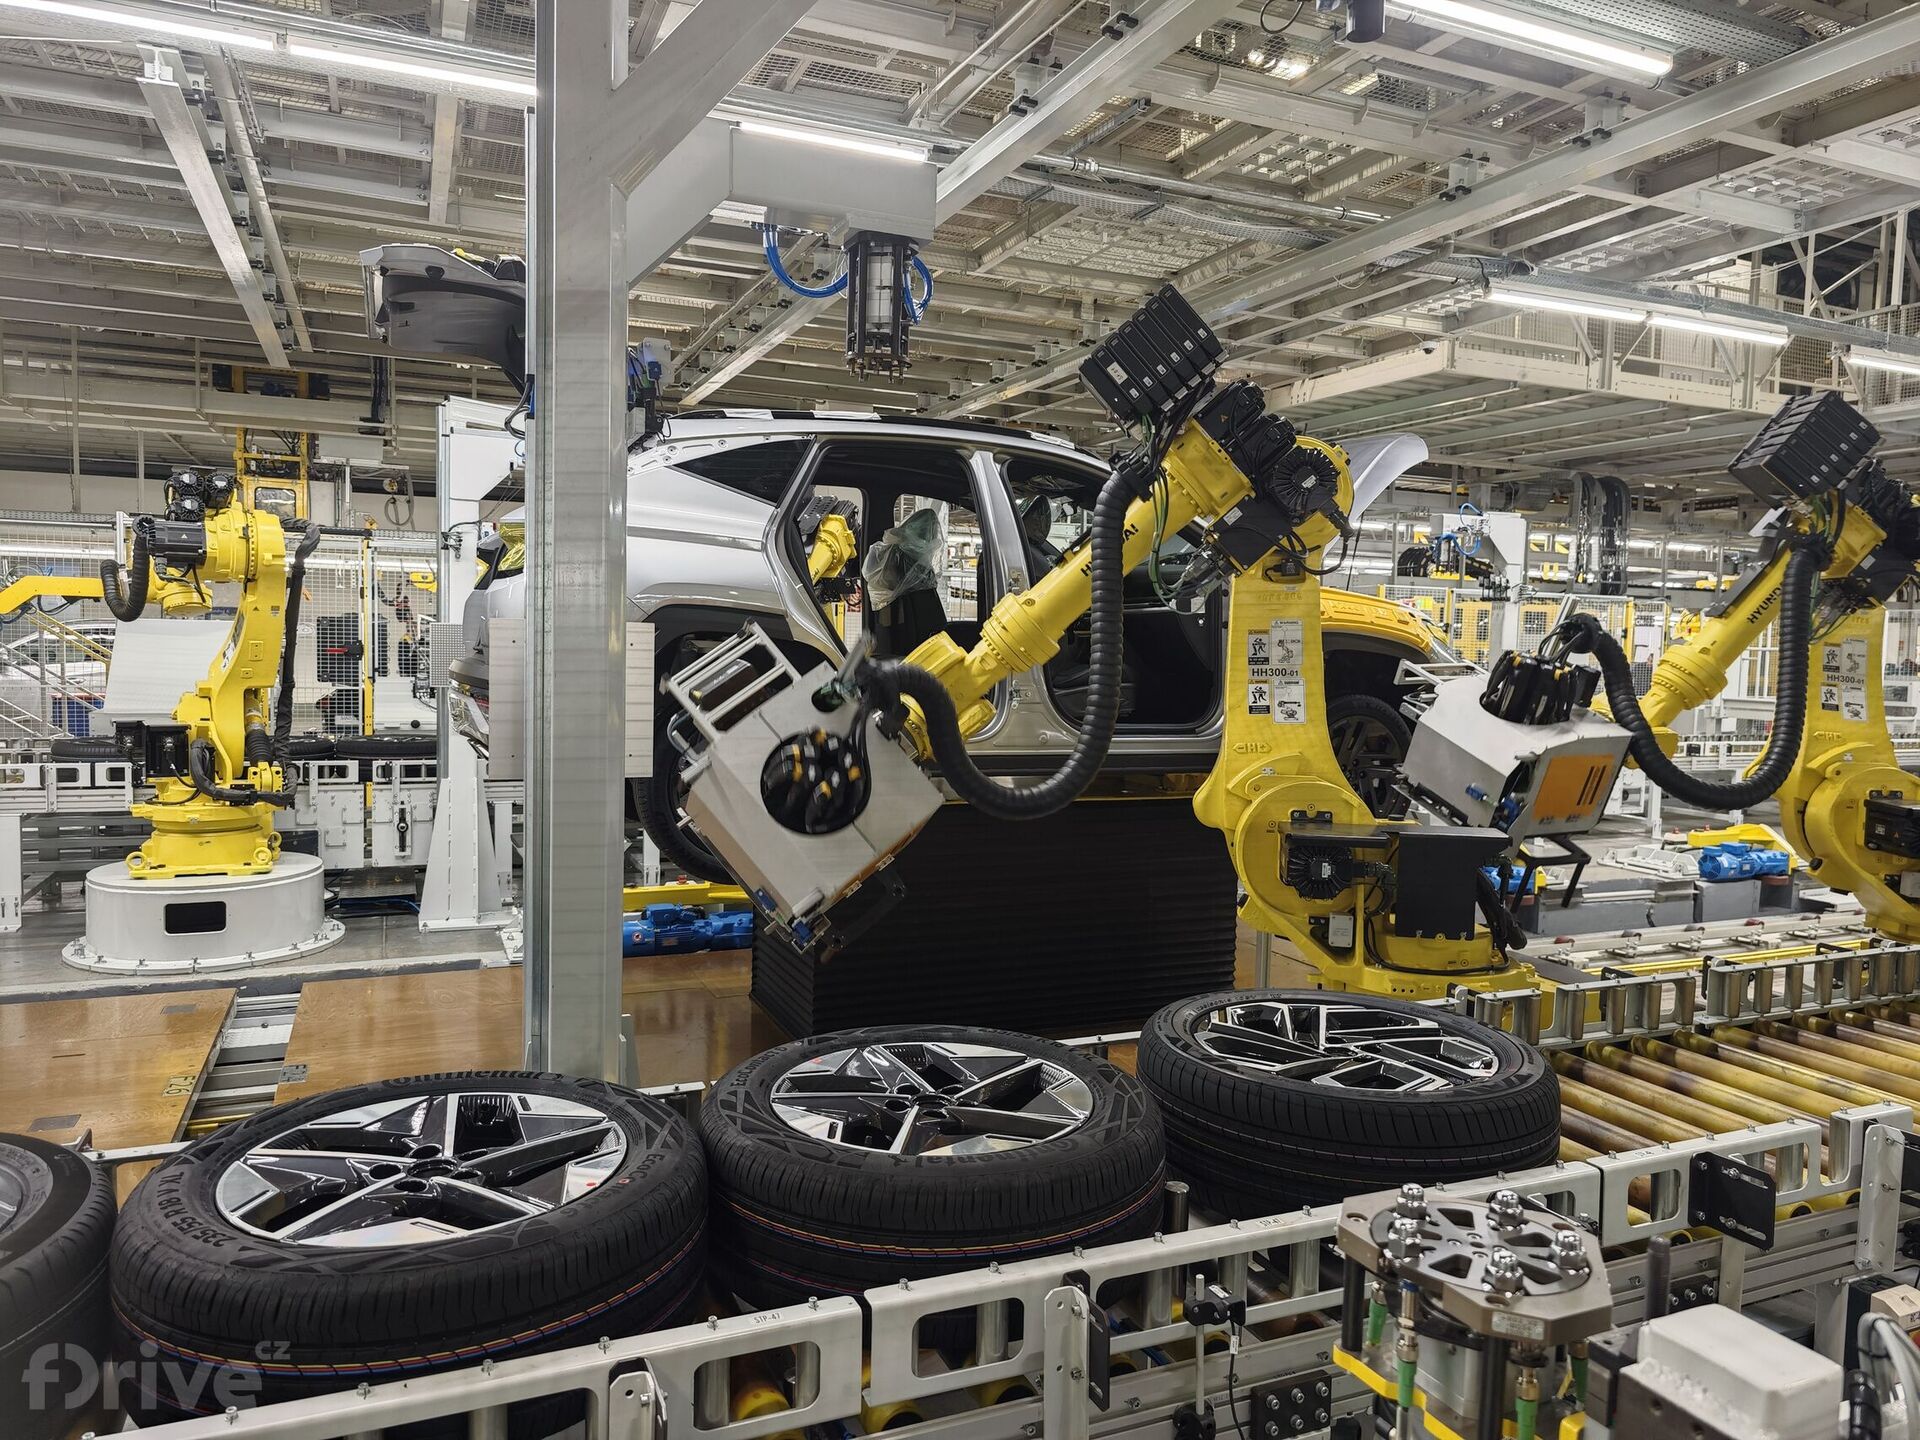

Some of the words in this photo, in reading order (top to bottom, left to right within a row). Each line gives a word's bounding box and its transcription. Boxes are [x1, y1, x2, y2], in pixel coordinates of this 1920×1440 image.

[1746, 582, 1783, 624] HYUND
[1252, 667, 1299, 677] HH300-01
[1826, 673, 1865, 685] HH300-01
[165, 1075, 196, 1095] F26
[171, 1216, 238, 1247] 235/55
